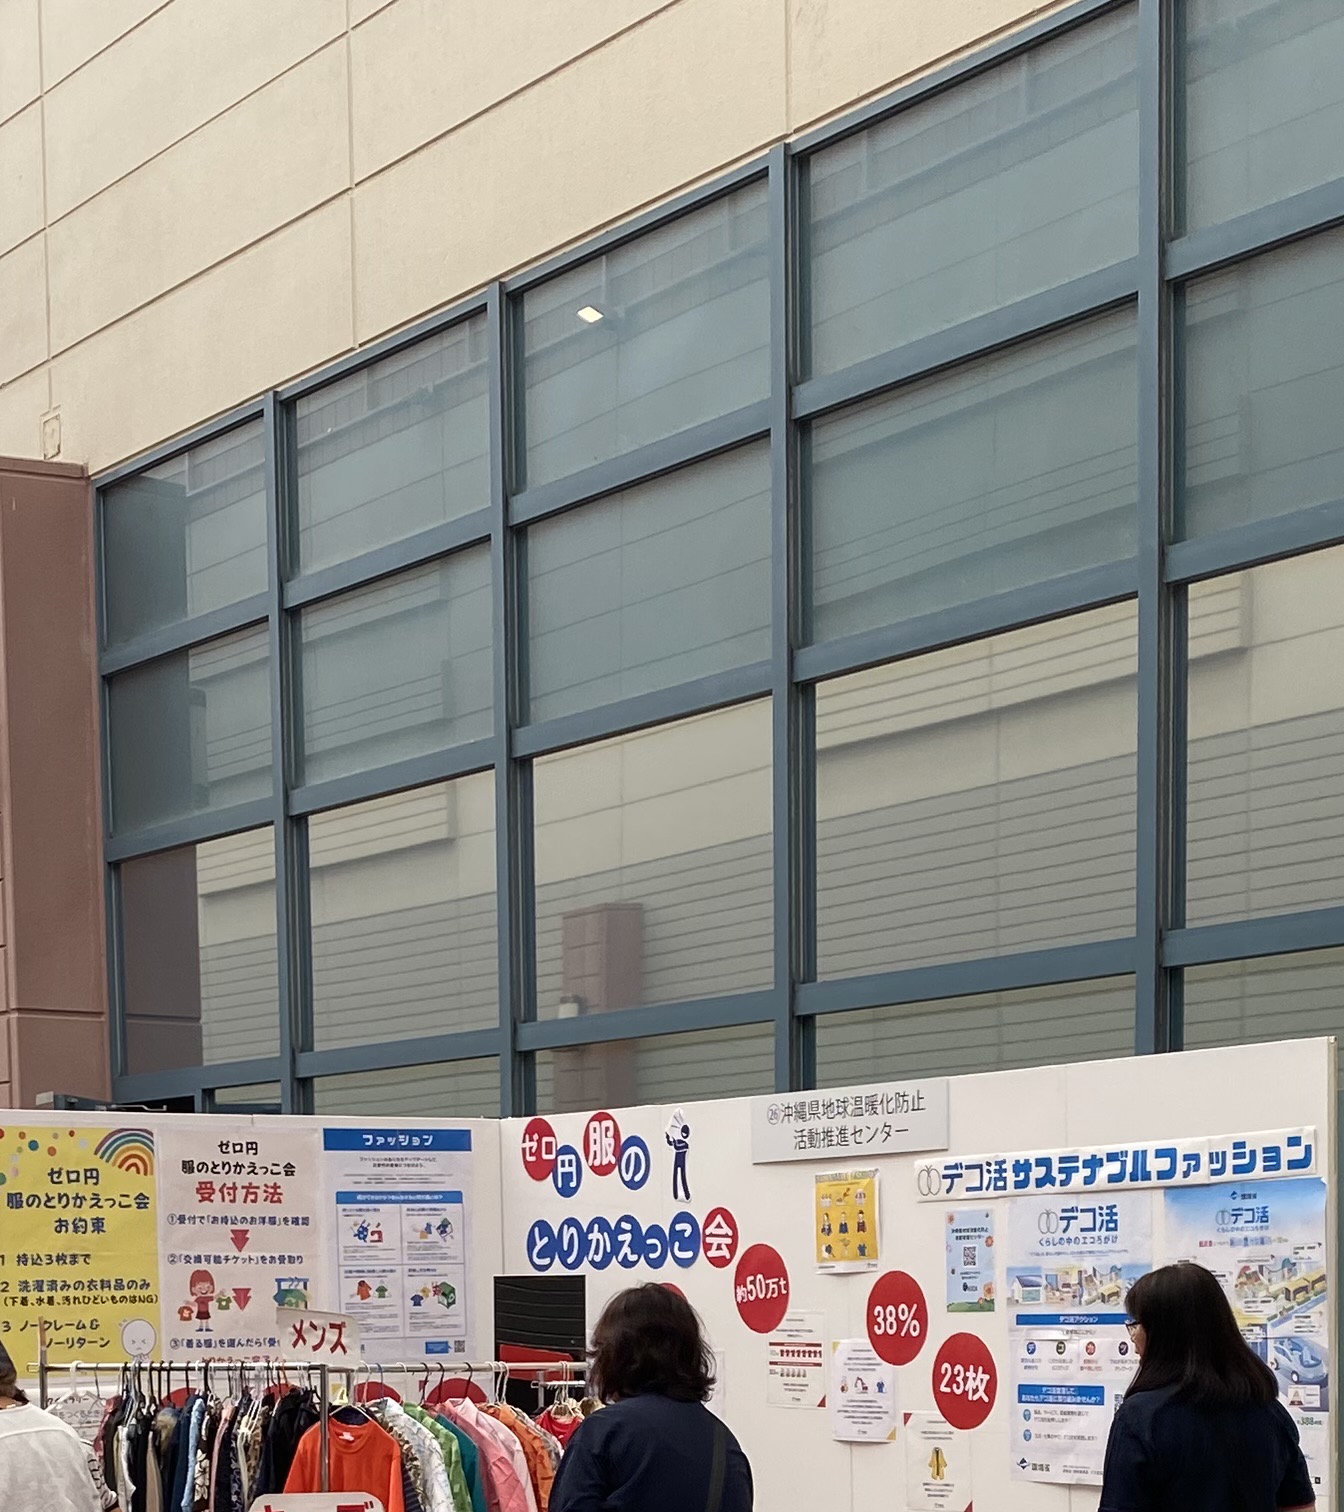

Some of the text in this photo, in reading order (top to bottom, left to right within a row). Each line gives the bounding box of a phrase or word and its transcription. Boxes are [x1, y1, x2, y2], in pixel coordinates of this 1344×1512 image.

[362, 1134, 434, 1147] ファッション
[794, 1122, 909, 1150] 活動推進センター
[217, 1140, 259, 1156] ゼロ円
[47, 1167, 100, 1186] ゼロ円
[181, 1159, 296, 1177] 服のとりかえっこ会
[6, 1192, 150, 1210] 服のとりかえっこ会
[195, 1181, 283, 1204] 受付方法
[1059, 1204, 1118, 1234] デコ活
[1231, 1205, 1269, 1224] デコ活
[54, 1216, 106, 1234] お約束
[530, 1213, 734, 1267] とりかえっこ会
[0, 1253, 91, 1267] 1 持込3枚まで
[0, 1279, 151, 1293] 2 洗濯済みの衣料品のみ
[735, 1274, 788, 1303] 約50万t
[2, 1321, 11, 1332] 3
[873, 1303, 921, 1338] 38%
[290, 1318, 348, 1355] メンズ
[939, 1362, 990, 1403] 23枚
